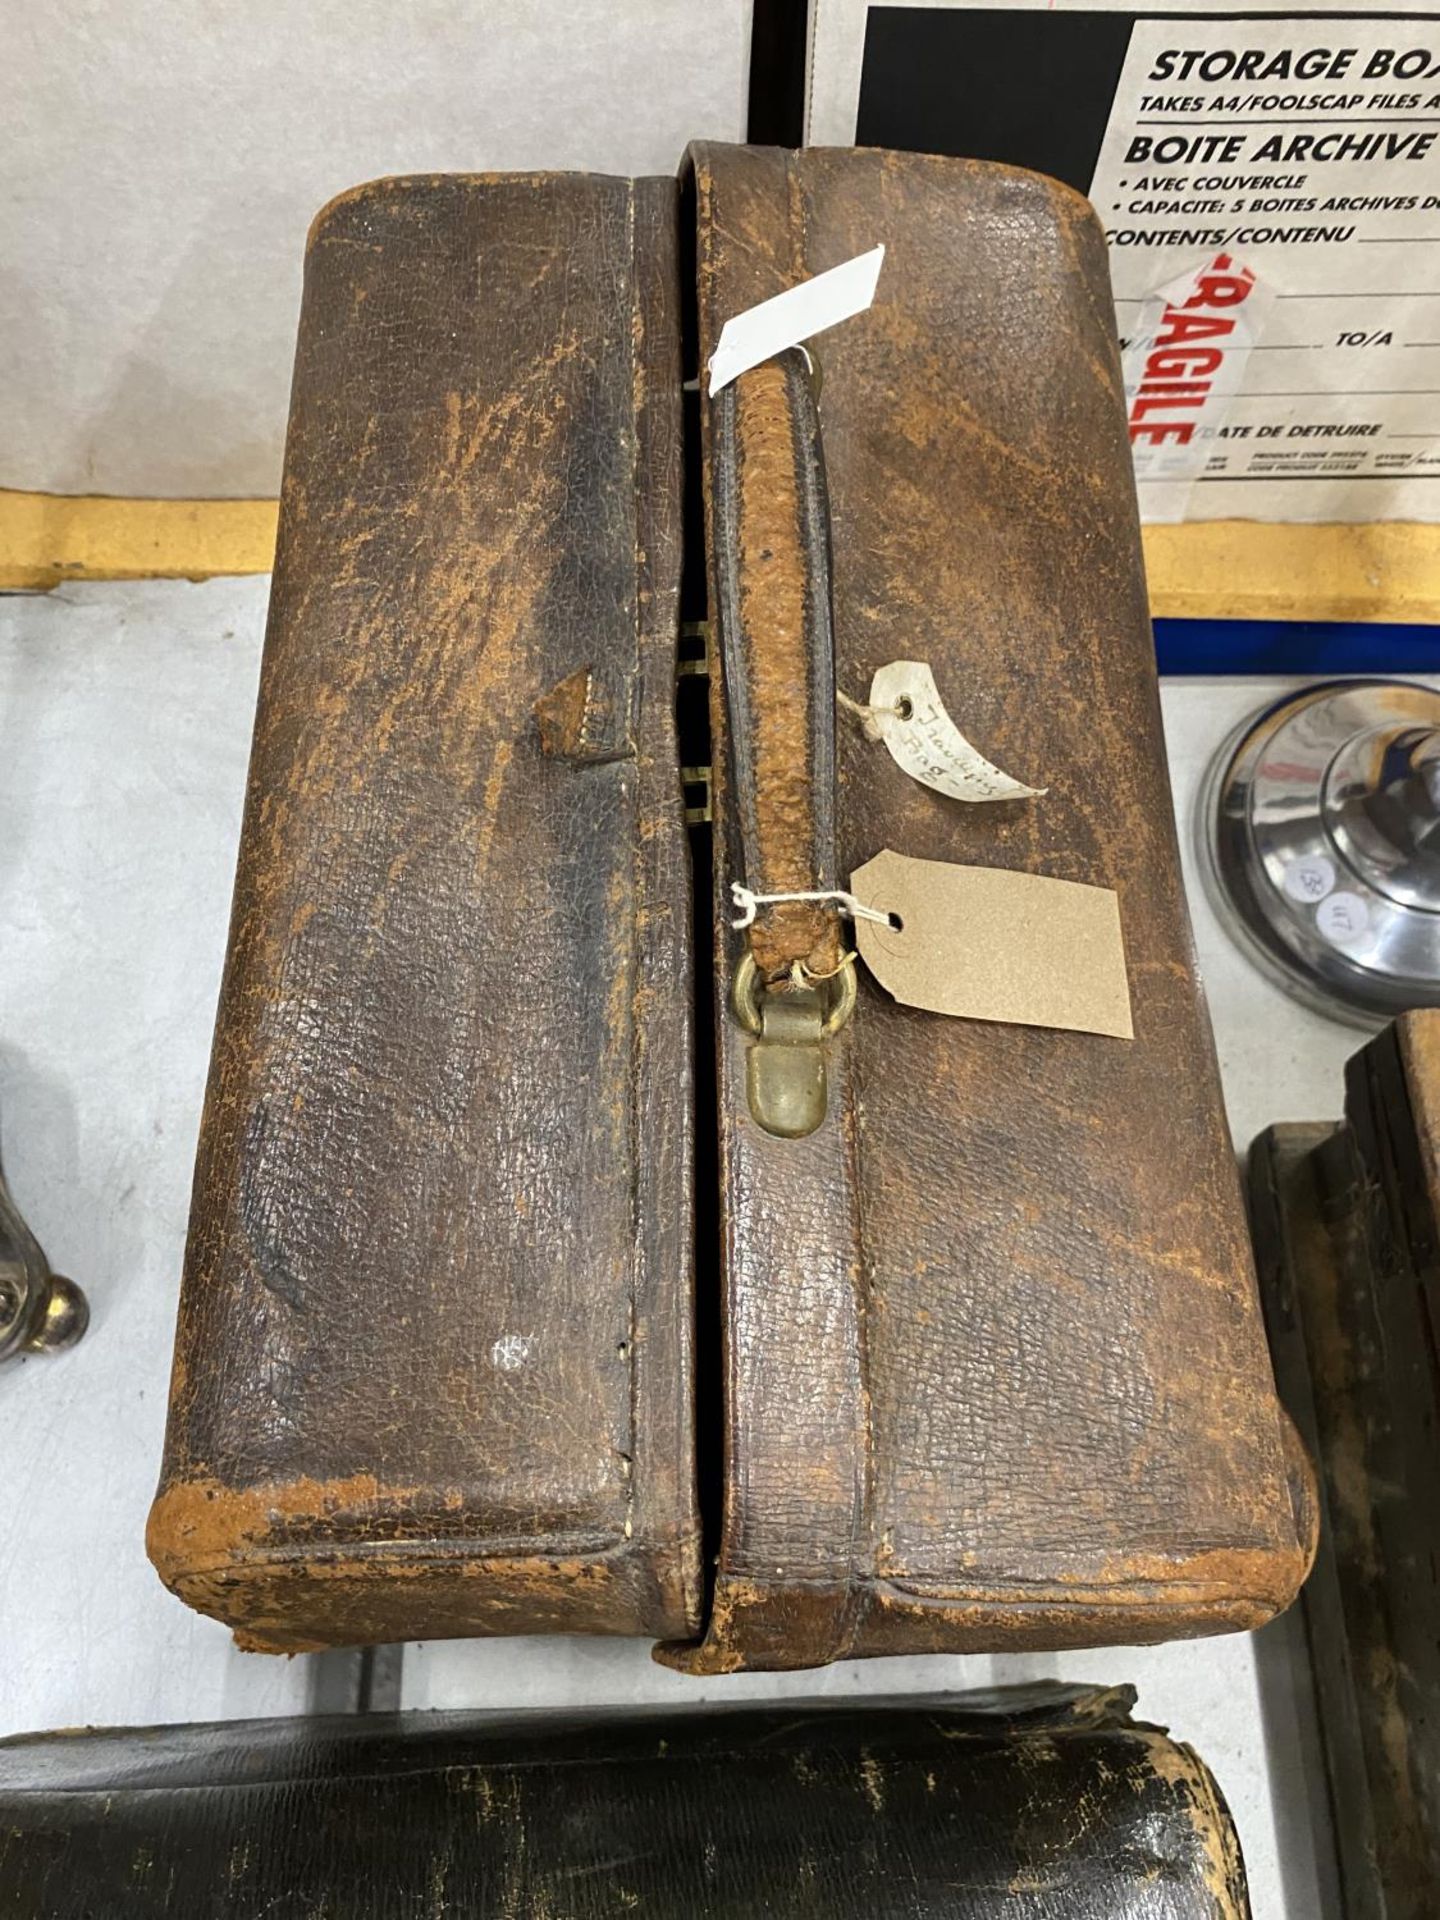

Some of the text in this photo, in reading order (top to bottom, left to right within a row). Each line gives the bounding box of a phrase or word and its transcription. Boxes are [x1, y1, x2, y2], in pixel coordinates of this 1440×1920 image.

[1148, 48, 1358, 81] STORAGE
[1139, 95, 1205, 112] TAKES
[1208, 94, 1364, 113] A4/FOOLSCAP
[1366, 93, 1419, 110] FILES
[1124, 132, 1438, 164] BOITE ARCHIVE
[1133, 174, 1308, 192] AVEC COUVERCLE
[1128, 199, 1226, 214] CAPACITE:
[1230, 199, 1245, 214] 5
[1250, 198, 1317, 213] BOITES
[1320, 196, 1419, 211] ARCHIVES
[1336, 329, 1394, 348] TO/A
[1256, 424, 1283, 440] DE
[1287, 423, 1384, 439] DETRUIRE
